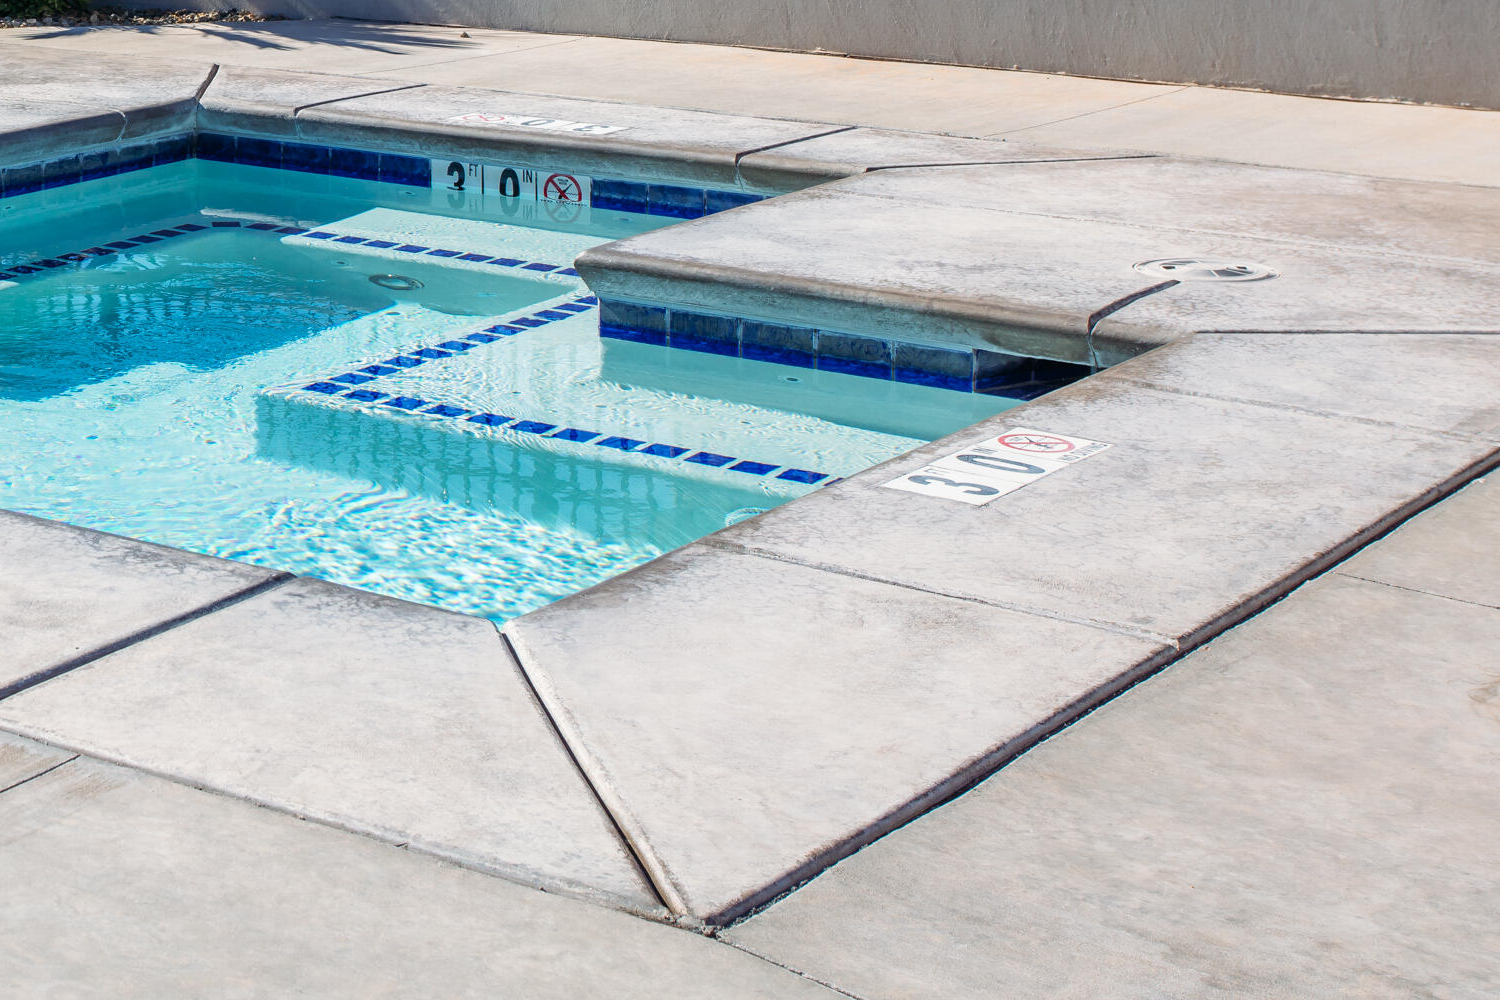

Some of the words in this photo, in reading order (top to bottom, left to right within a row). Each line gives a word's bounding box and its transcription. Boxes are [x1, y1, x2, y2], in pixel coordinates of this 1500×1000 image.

[447, 161, 466, 190] 3
[468, 163, 479, 177] FT
[500, 167, 520, 198] 0
[522, 169, 533, 184] IN
[907, 474, 1000, 496] 3
[955, 454, 1046, 474] 0
